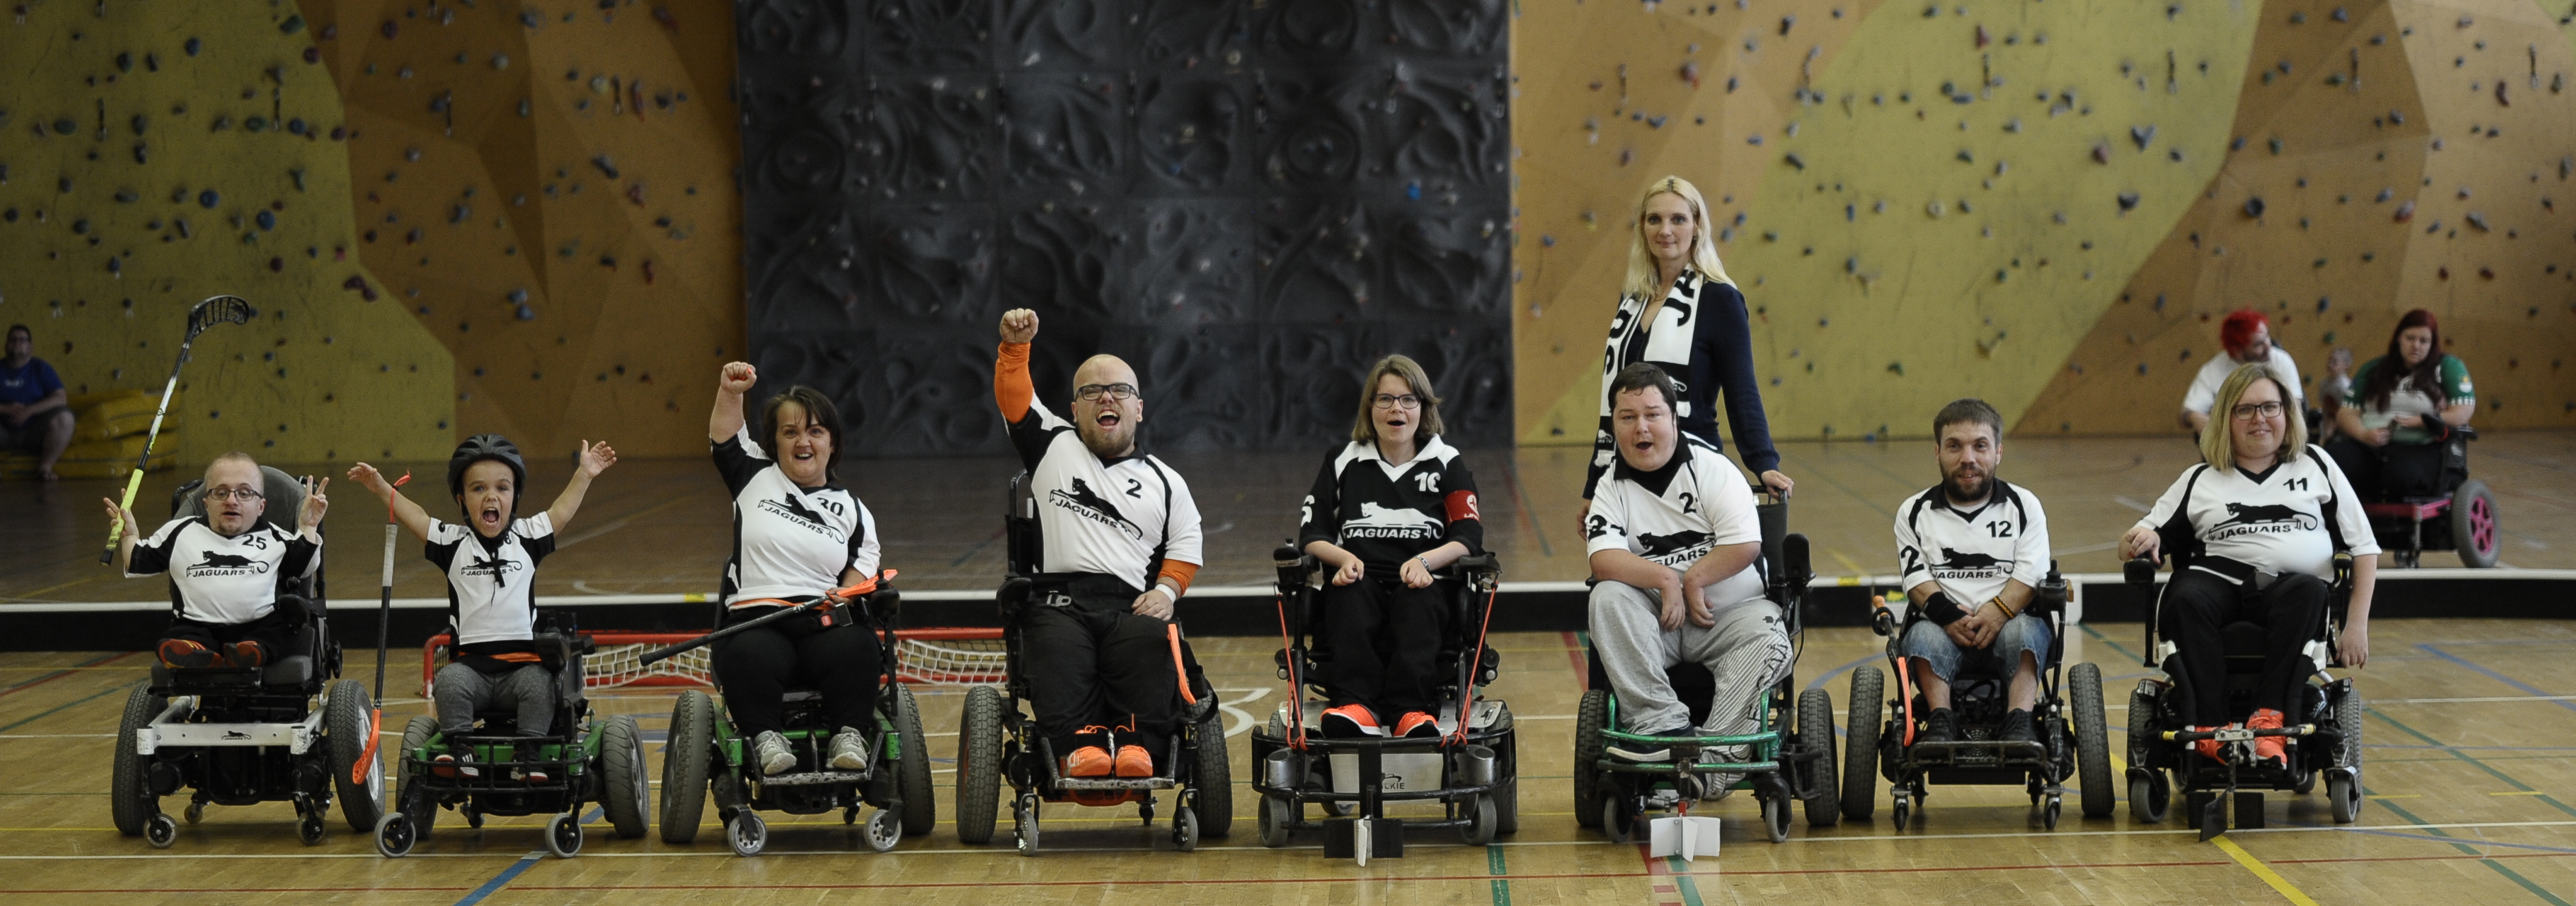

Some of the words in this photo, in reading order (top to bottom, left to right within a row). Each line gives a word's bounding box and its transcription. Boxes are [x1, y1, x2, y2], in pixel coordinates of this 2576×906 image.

[1126, 478, 1142, 499] 2
[2283, 478, 2308, 491] 11
[817, 497, 844, 517] 30
[1056, 499, 1118, 529] JAGUARS
[764, 507, 824, 534] JAGUARS
[1986, 520, 2012, 538] 12
[1346, 528, 1422, 539] JAGUARS
[2217, 524, 2291, 540] JAGUARS
[242, 534, 267, 550] 25
[1654, 547, 1708, 566] UARS
